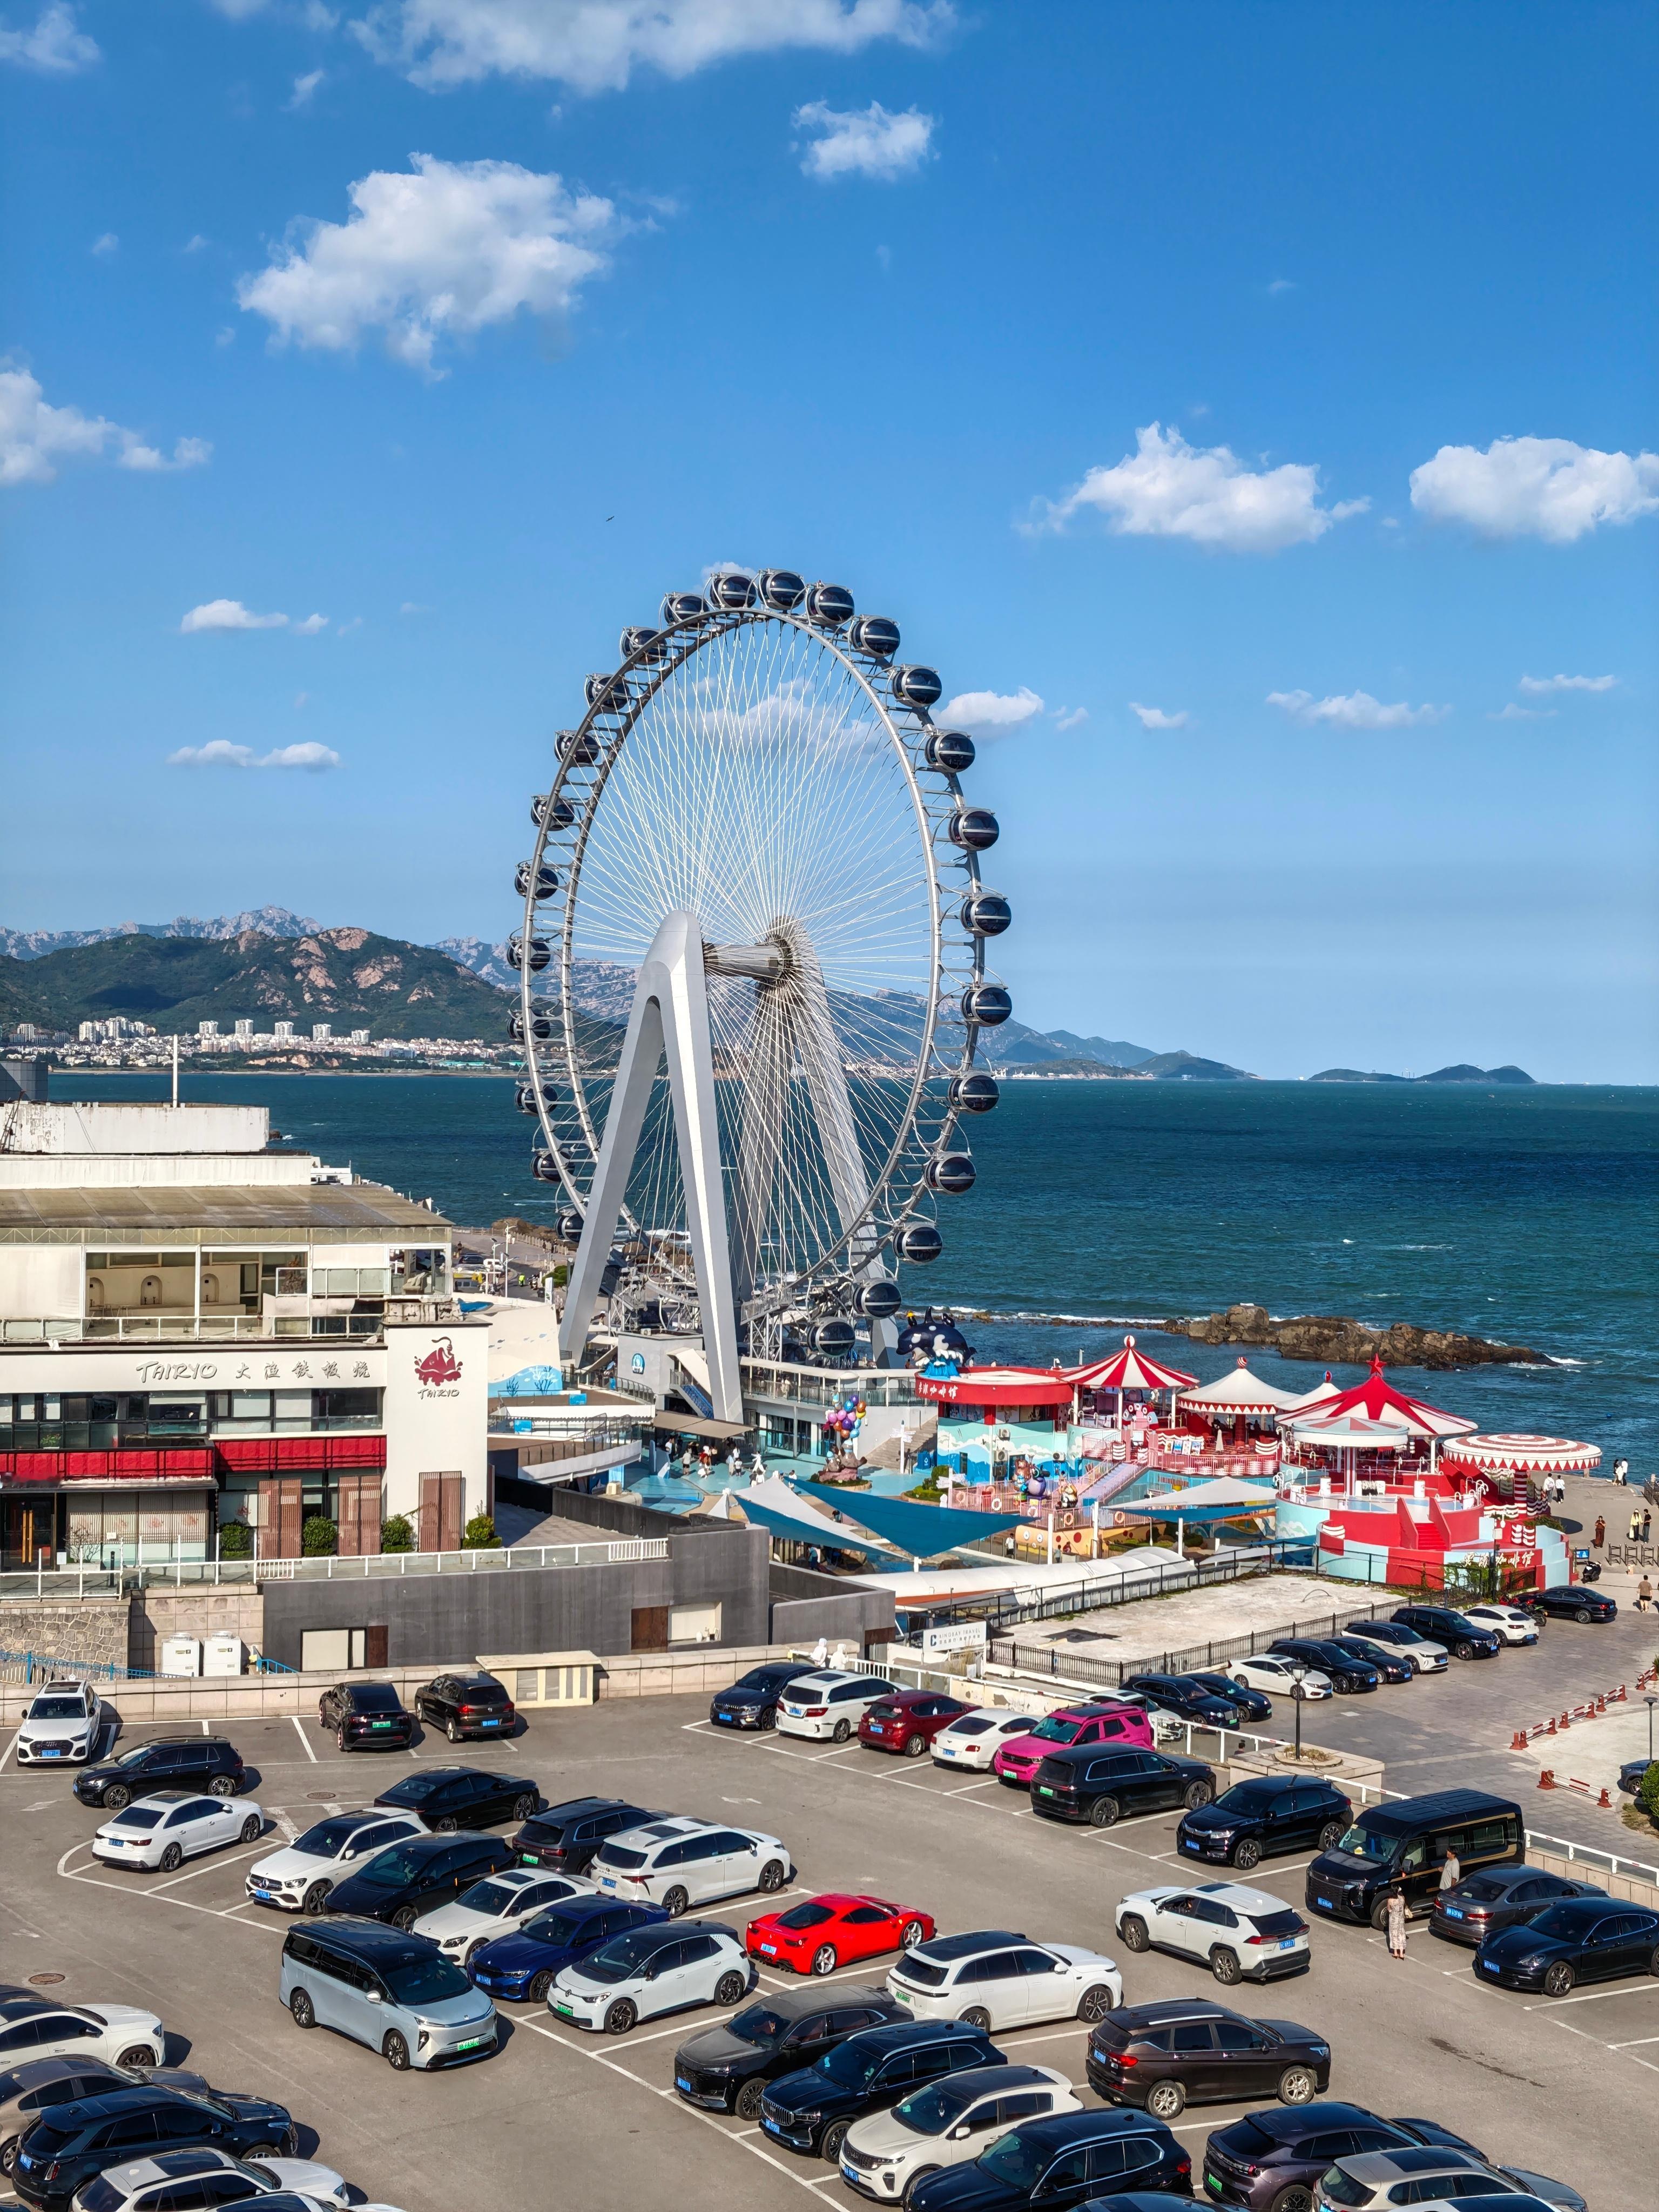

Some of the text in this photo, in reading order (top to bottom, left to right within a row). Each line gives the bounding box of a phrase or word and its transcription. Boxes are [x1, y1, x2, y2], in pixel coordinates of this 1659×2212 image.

[136, 1361, 217, 1383] TAIRYO
[235, 1360, 371, 1379] 大渔铁板烧
[417, 1388, 460, 1400] TAIRYO
